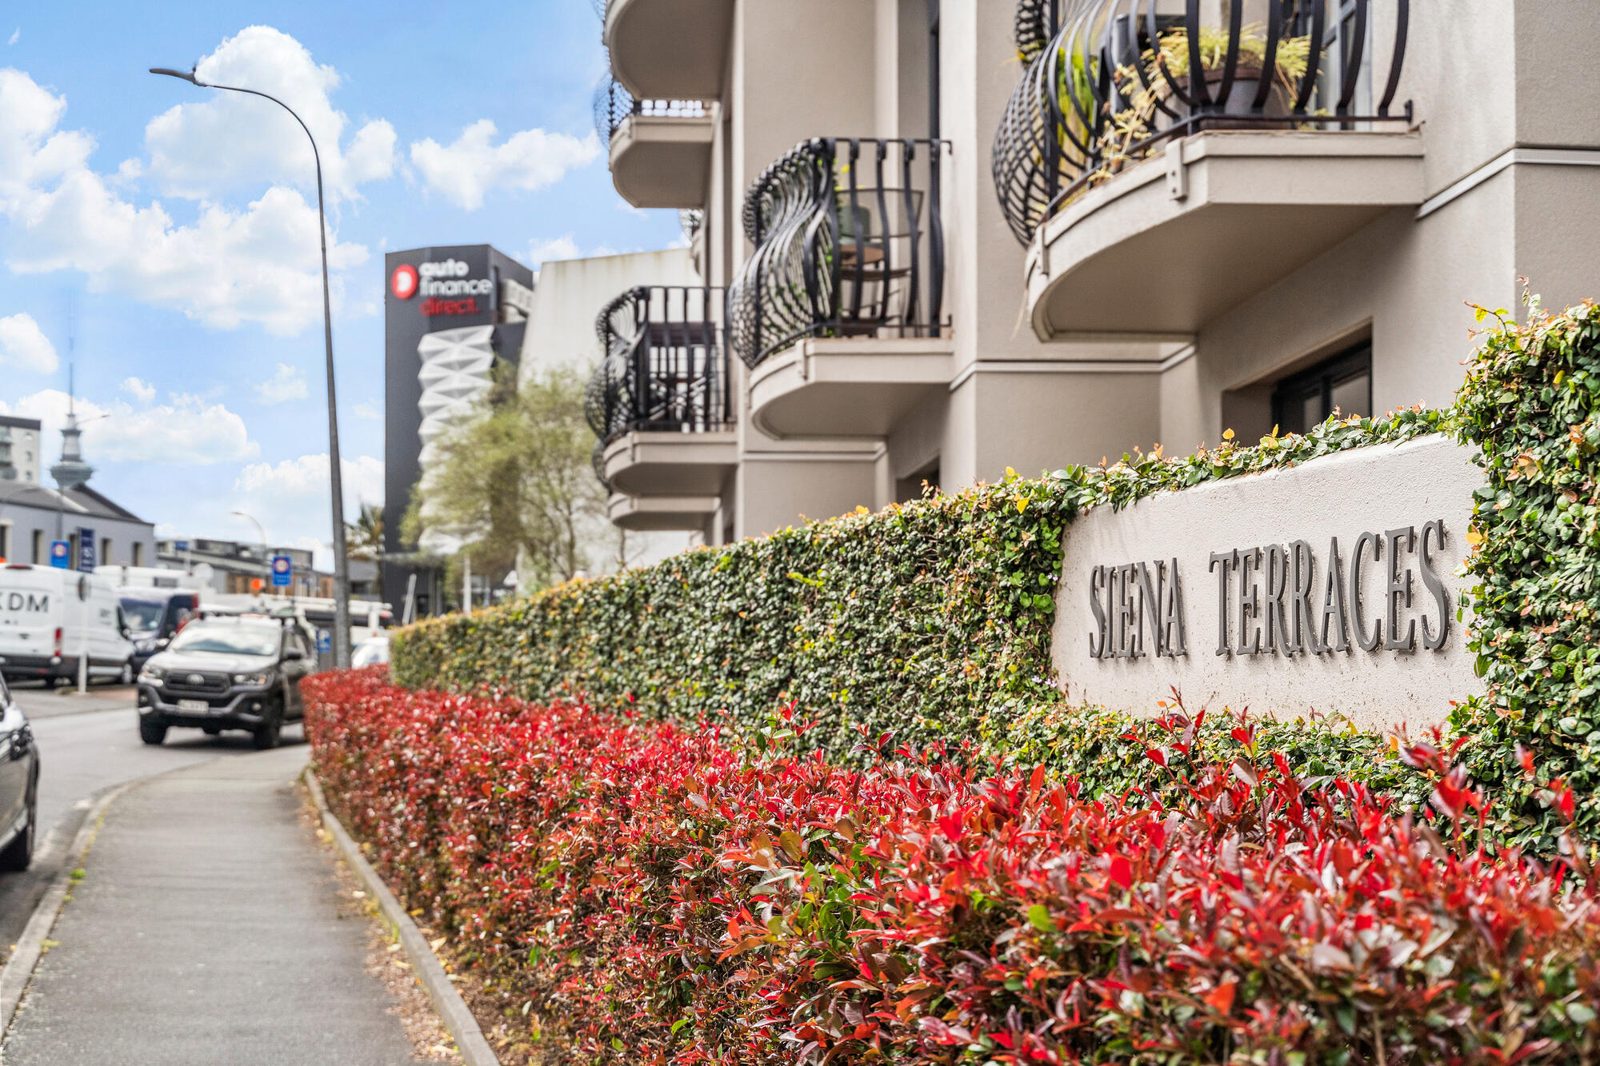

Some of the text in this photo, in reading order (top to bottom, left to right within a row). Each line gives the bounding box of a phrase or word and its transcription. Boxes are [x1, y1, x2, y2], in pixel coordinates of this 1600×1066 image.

[419, 259, 469, 276] auto
[420, 276, 492, 296] finance
[1089, 519, 1450, 658] SIENA TERRACES
